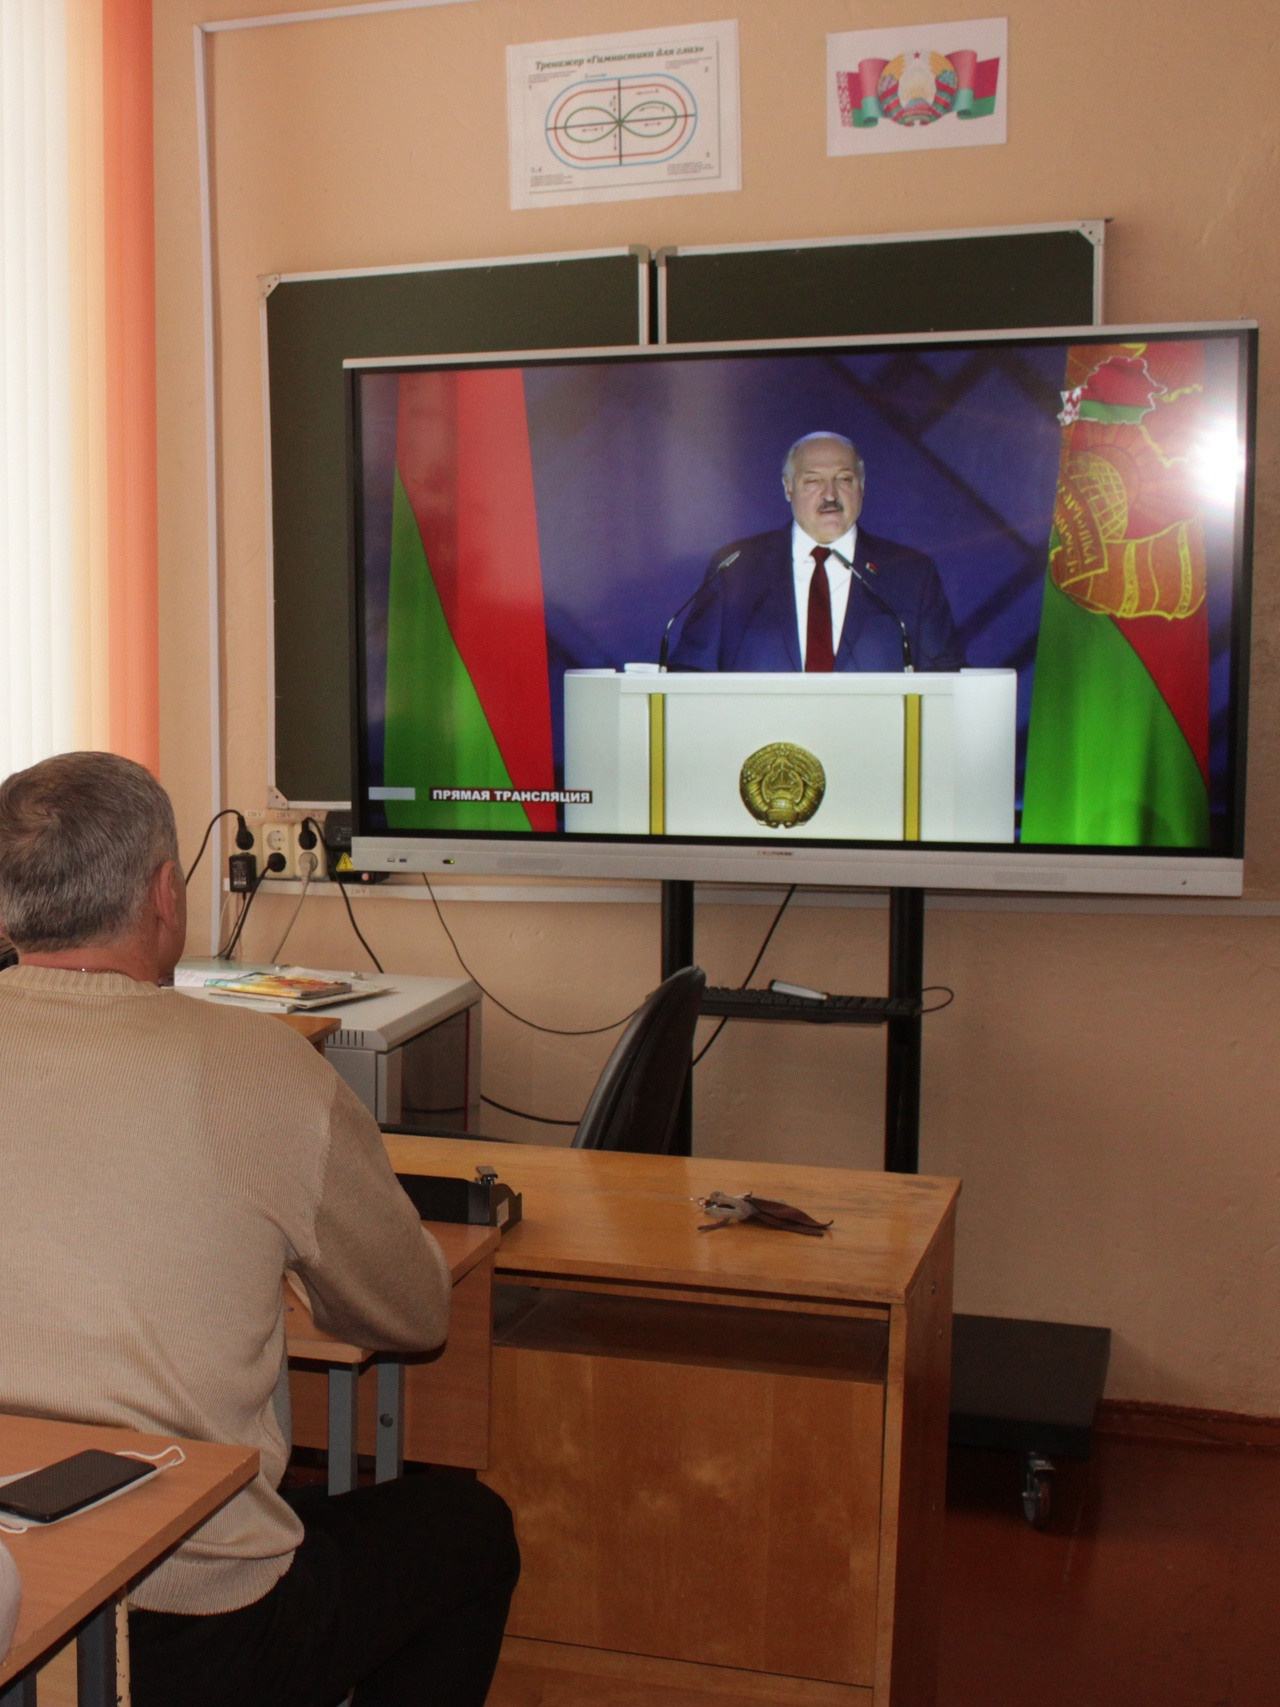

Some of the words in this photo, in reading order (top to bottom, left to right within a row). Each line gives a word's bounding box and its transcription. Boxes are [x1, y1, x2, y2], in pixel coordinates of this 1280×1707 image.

[535, 57, 584, 71] Тренажер
[586, 51, 654, 64] «Гимнастика
[656, 47, 674, 57] для
[432, 789, 490, 801] ПРЯМАЯ
[494, 791, 590, 803] ТРАНСЛЯЦИЯ
